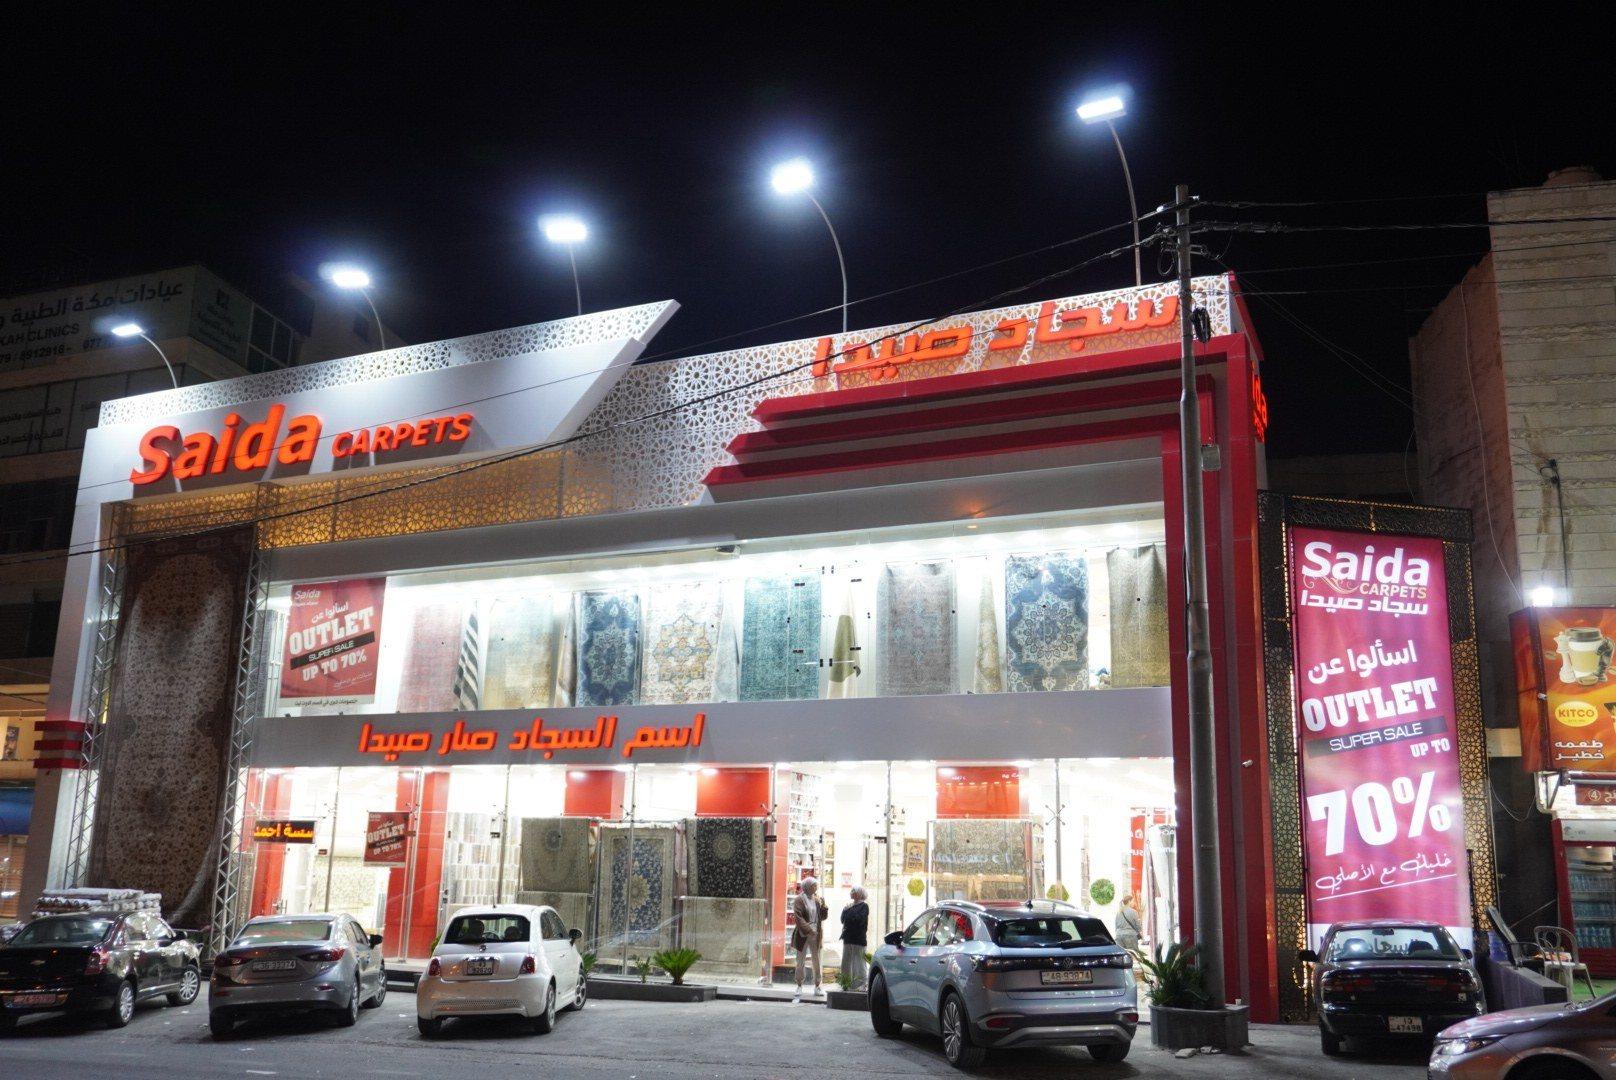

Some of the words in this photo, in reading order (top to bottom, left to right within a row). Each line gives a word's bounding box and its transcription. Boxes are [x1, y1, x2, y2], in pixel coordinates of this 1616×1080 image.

[72, 292, 112, 312] مكة
[120, 280, 183, 304] عيادات
[11, 299, 66, 327] الطبية
[988, 295, 1181, 352] سجاد
[27, 323, 80, 342] CLINICS
[812, 325, 973, 380] صيدا
[129, 402, 324, 486] Saida
[330, 412, 475, 459] CARPETS
[1301, 541, 1430, 586] Saida
[1300, 589, 1363, 614] صيدا
[1359, 582, 1427, 599] CARPETS
[1368, 595, 1429, 618] سجاد
[289, 606, 374, 655] OUTLET
[334, 640, 355, 653] SALE
[1346, 638, 1418, 678] اسألوا
[302, 665, 319, 682] UP
[320, 659, 338, 675] TO
[342, 648, 367, 669] 70%
[1307, 657, 1345, 684] عن
[1301, 677, 1438, 732] OUTLET
[1558, 709, 1595, 718] KITCO
[359, 722, 432, 762] صيدا
[438, 720, 498, 756] صار
[508, 715, 618, 760] السجاد
[621, 712, 706, 758] اسم
[1329, 731, 1382, 752] SUPER
[1384, 722, 1424, 741] SALE
[1410, 743, 1429, 758] UP
[1431, 737, 1451, 753] TO
[1555, 750, 1604, 762] خطير
[1306, 770, 1453, 857] 70%
[367, 823, 404, 843] OUTLET
